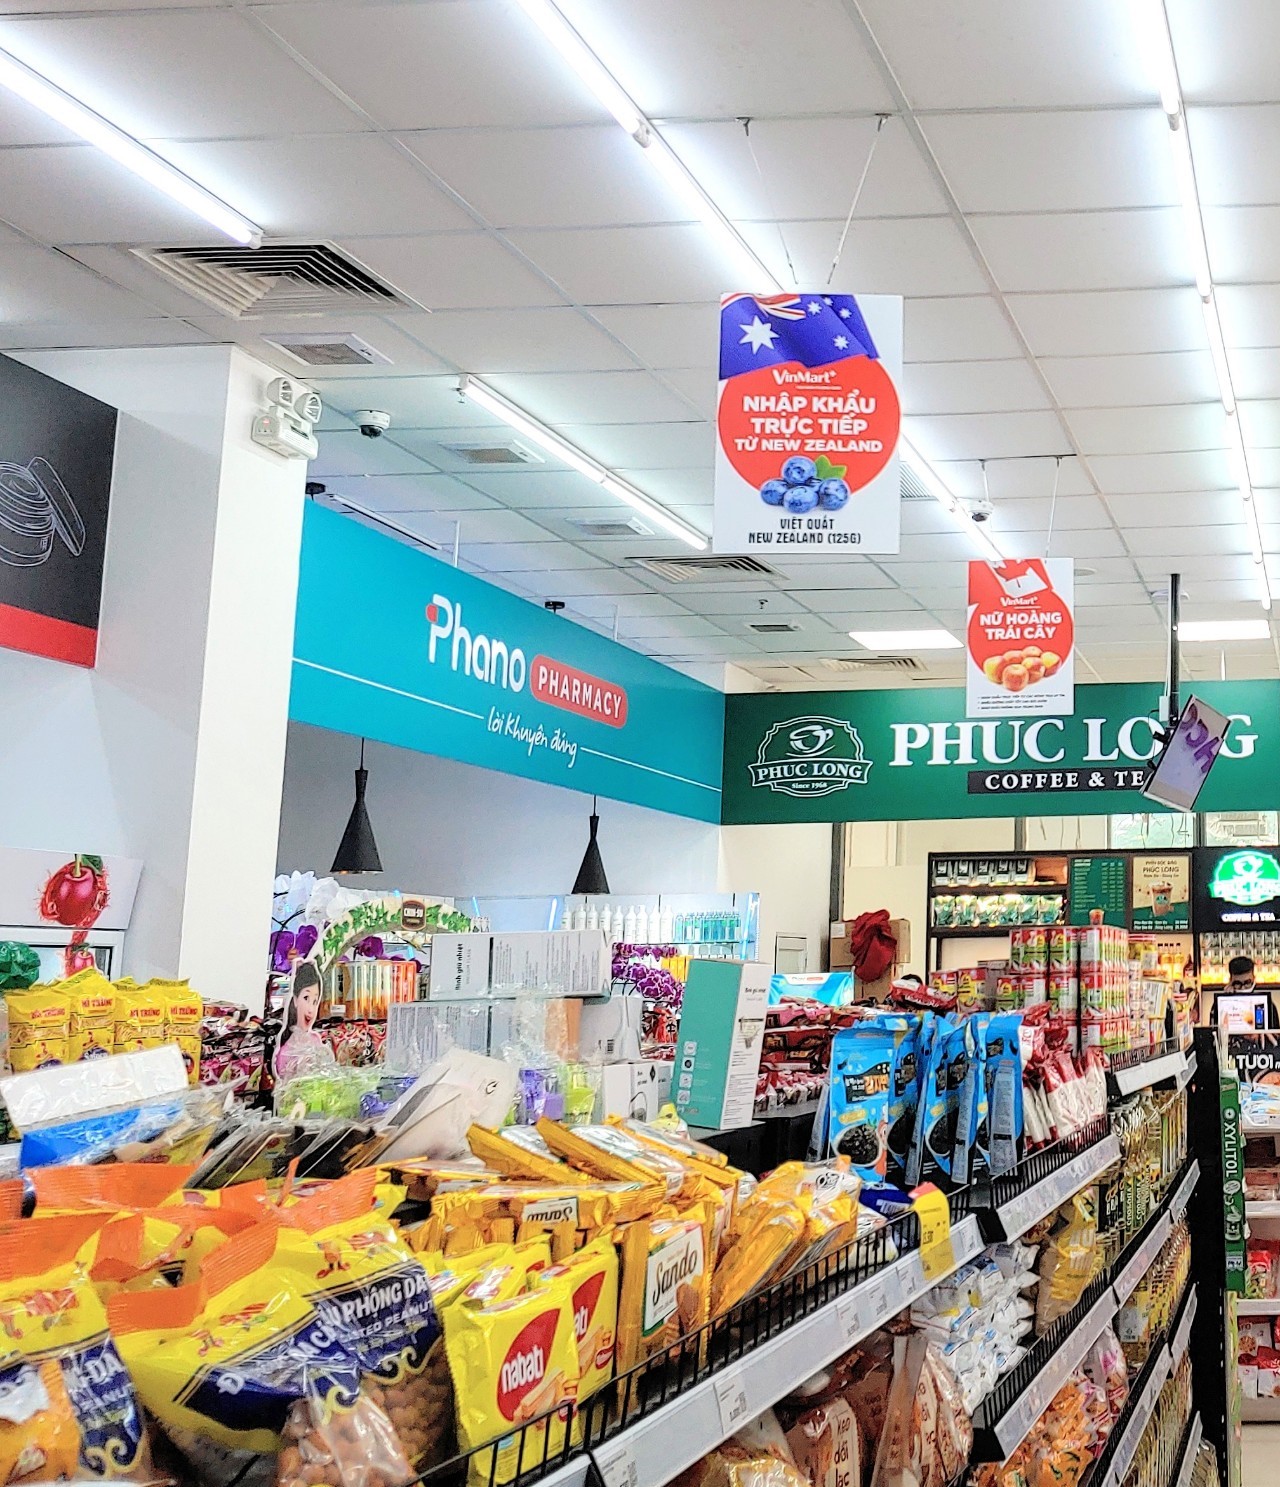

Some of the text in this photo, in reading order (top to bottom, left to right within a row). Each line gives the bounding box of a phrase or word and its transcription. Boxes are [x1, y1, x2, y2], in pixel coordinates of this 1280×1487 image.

[743, 389, 876, 420] NHẬP KHẨU
[751, 413, 868, 438] TRỰC TIẾP
[761, 439, 801, 452] NEW
[804, 439, 883, 453] ZEALAND
[748, 532, 861, 544] NEW ZEALAND (125G)
[980, 610, 1062, 626] NỮ HOÀNG
[985, 626, 1056, 640] TRÁI CÂY
[426, 593, 622, 719] Phano PHARMACY
[888, 717, 1066, 767] PHUC
[1082, 714, 1259, 763] LOG
[757, 763, 863, 781] PHUC LONG
[984, 770, 1145, 790] COFFEE & TE
[1236, 1053, 1273, 1070] TƯƠI
[1224, 1122, 1239, 1178] XYLITOL
[652, 1241, 698, 1306] Sando
[501, 1344, 545, 1396] nabati
